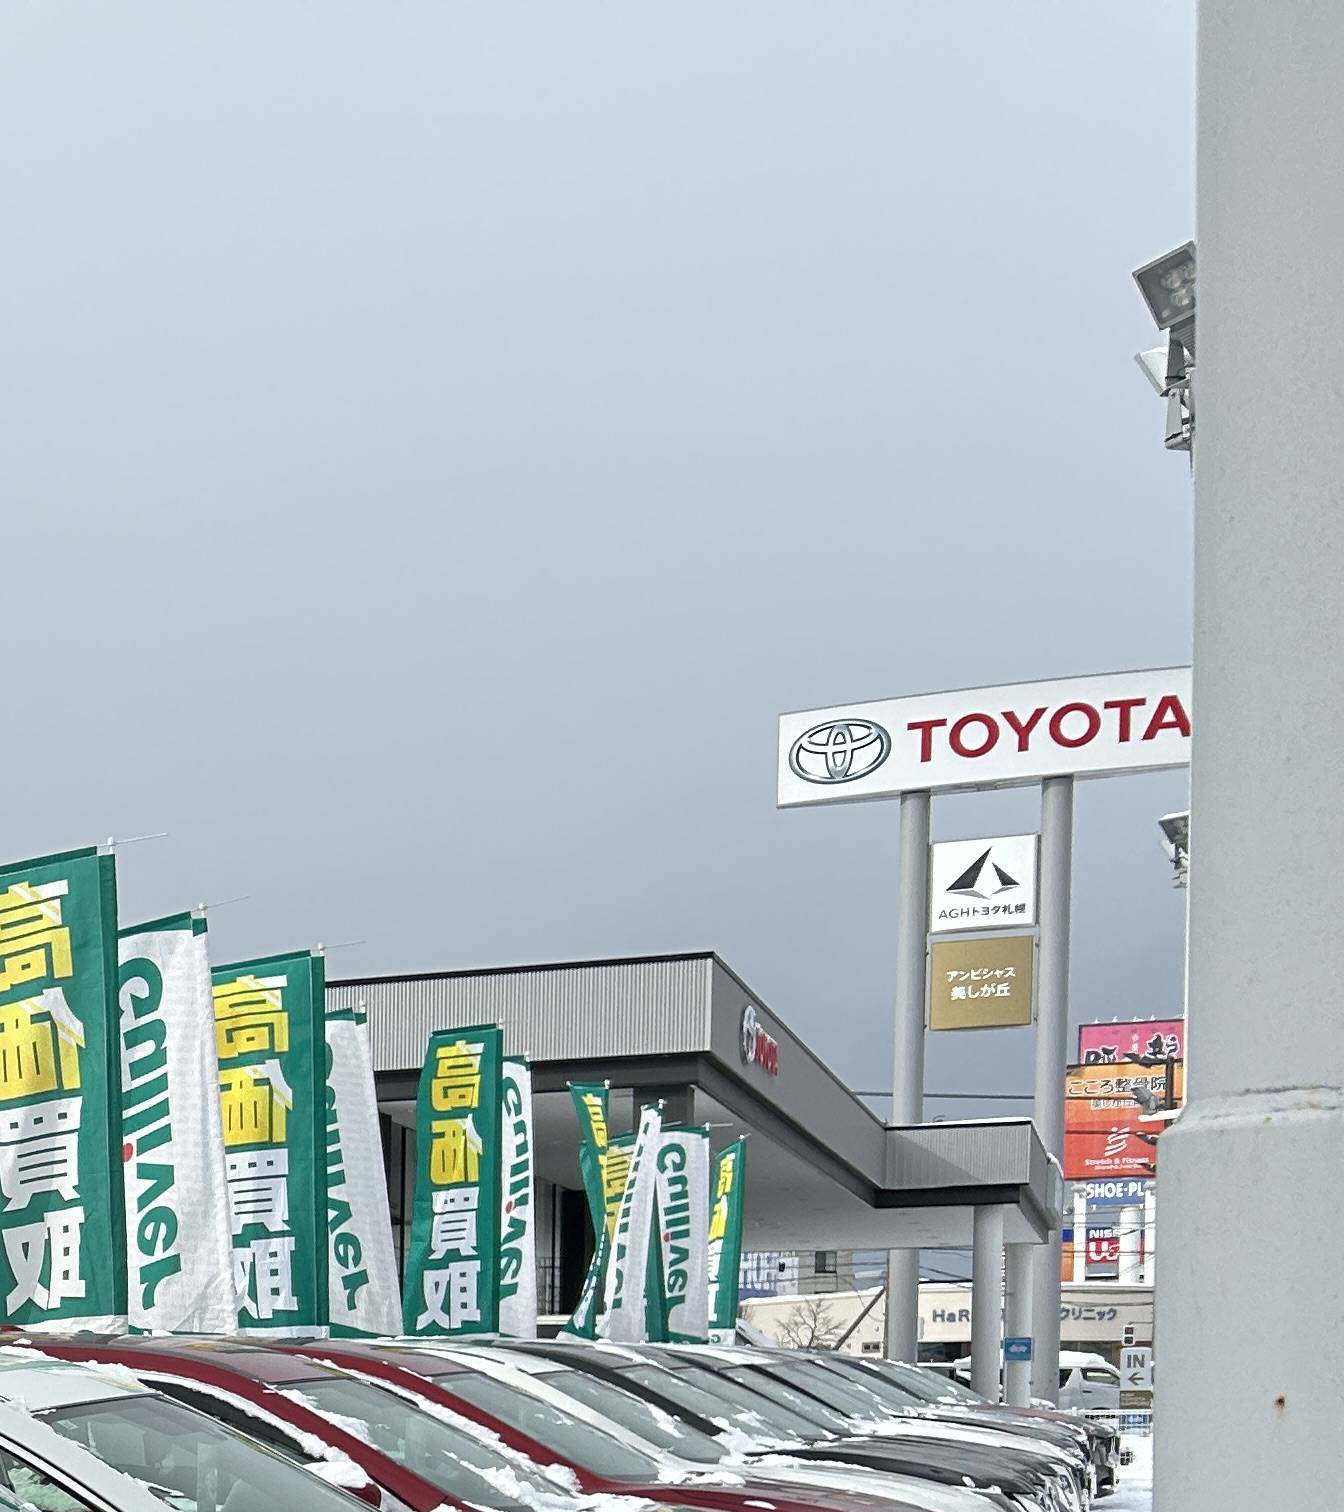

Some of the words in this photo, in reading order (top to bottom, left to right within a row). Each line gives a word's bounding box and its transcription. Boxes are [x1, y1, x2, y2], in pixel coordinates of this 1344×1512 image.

[907, 695, 1192, 763] TOYOTA
[950, 982, 1011, 1001] 美しが丘
[1127, 1354, 1146, 1368] IN
